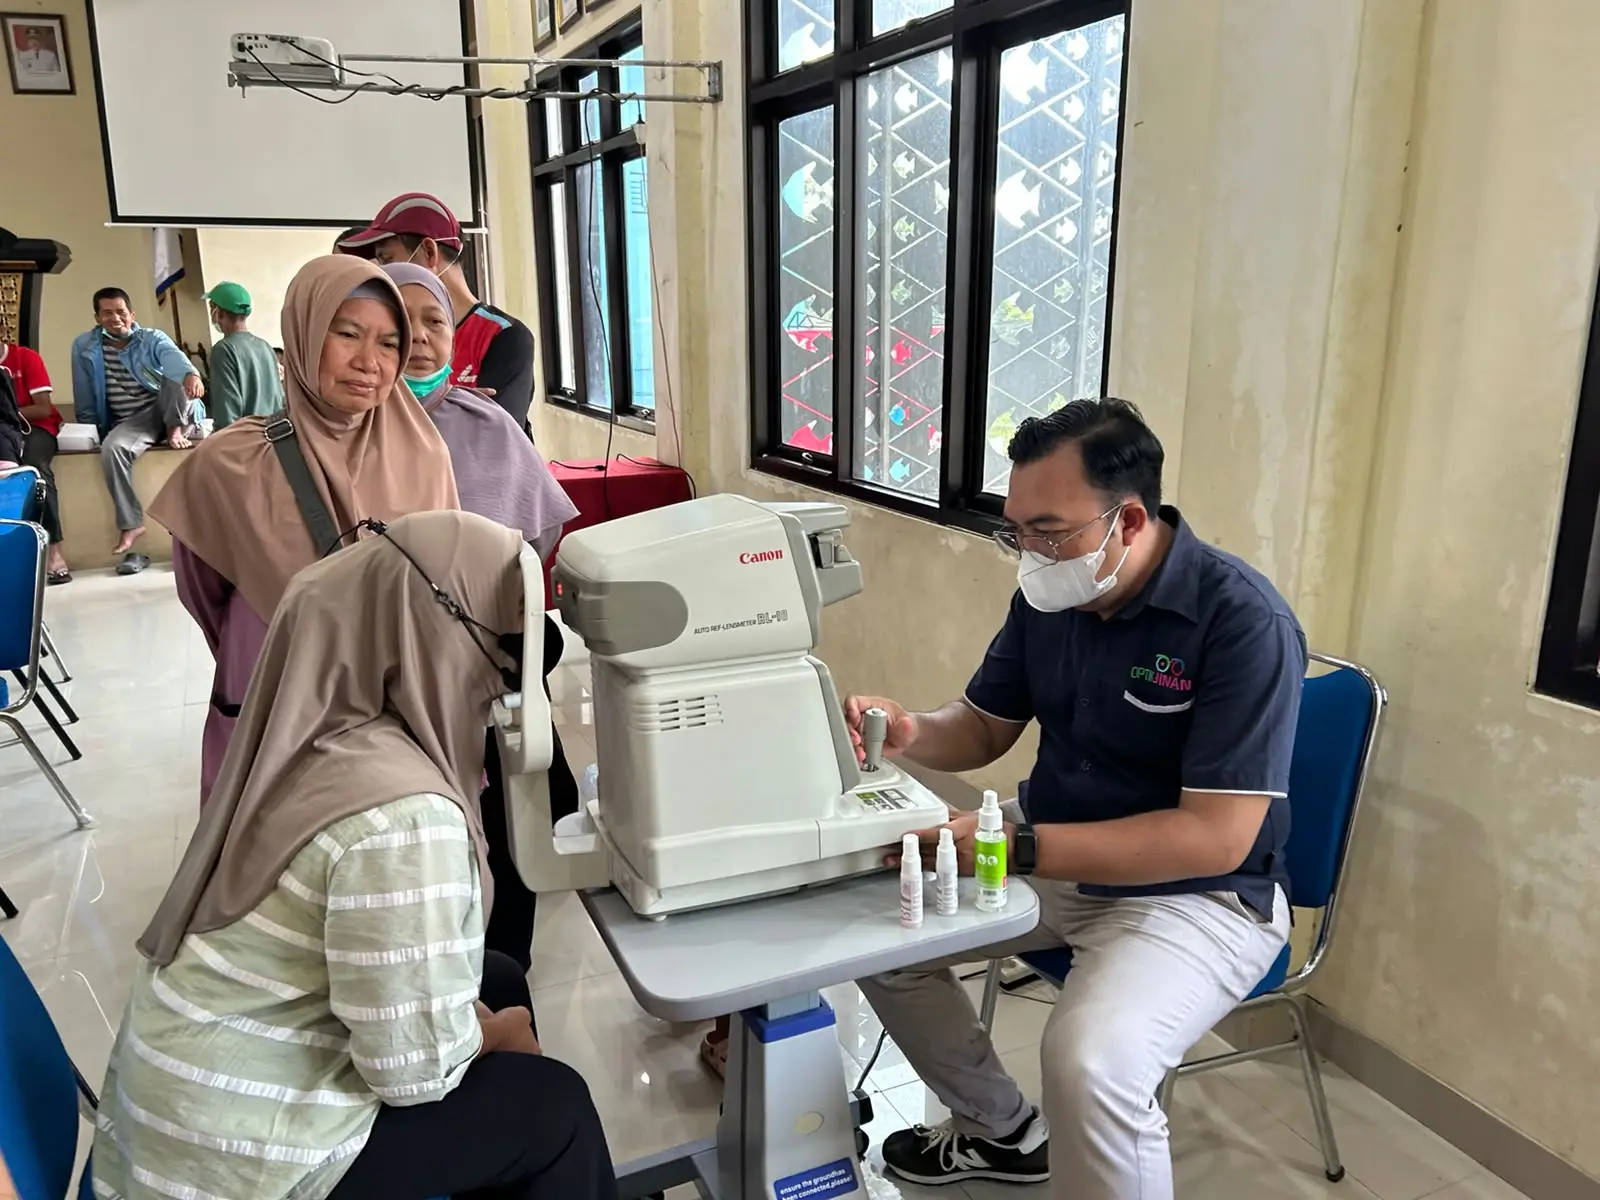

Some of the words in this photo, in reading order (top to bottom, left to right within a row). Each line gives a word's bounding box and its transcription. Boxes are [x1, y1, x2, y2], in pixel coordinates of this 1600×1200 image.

[739, 549, 784, 565] Canon
[694, 626, 710, 635] AUTO
[757, 609, 788, 625] RL-10
[780, 1184, 801, 1195] ensure
[801, 1180, 812, 1188] the
